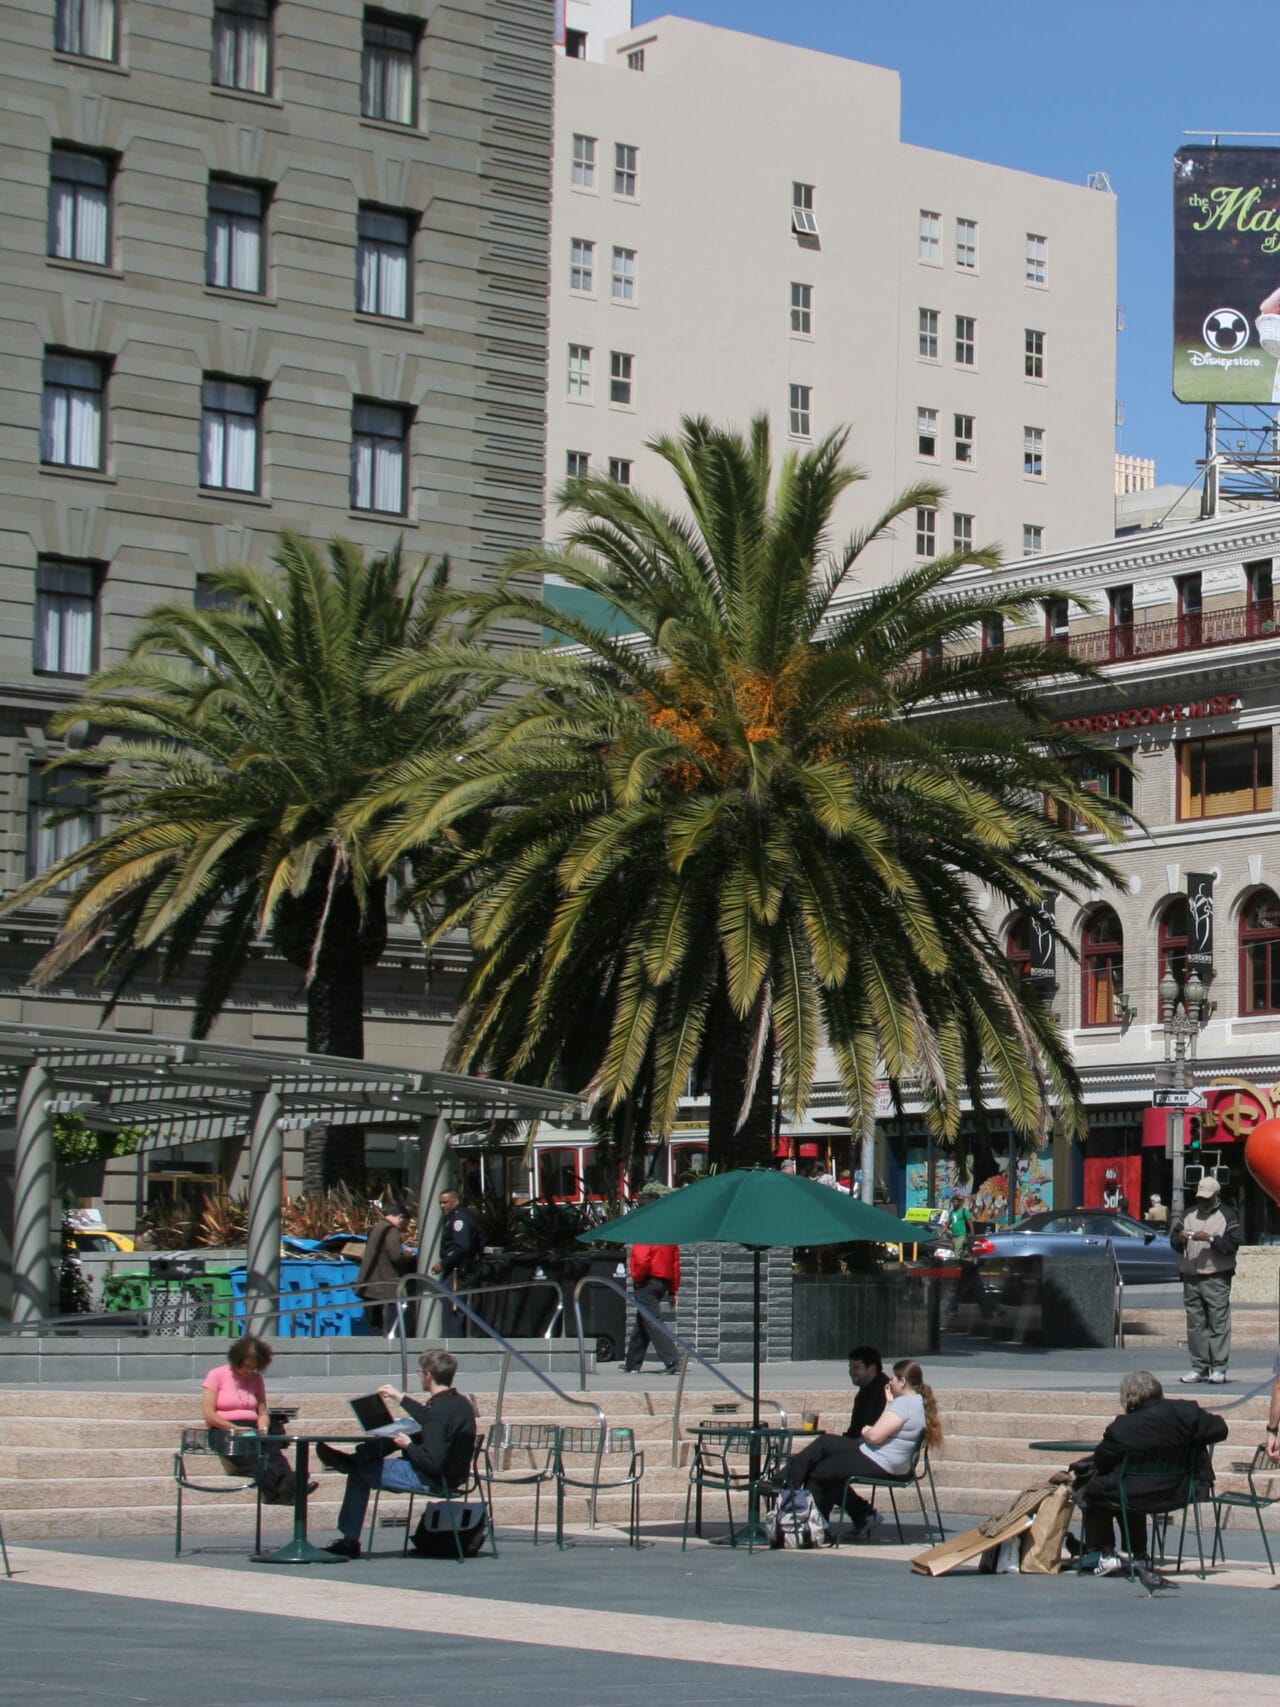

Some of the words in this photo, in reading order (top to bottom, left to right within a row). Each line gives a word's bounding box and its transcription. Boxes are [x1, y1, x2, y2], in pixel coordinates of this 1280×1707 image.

[1188, 193, 1209, 207] the
[1116, 704, 1171, 729] BOOKS
[1173, 703, 1184, 721] &
[1188, 694, 1239, 718] MUSIC
[1104, 1189, 1123, 1209] Sal
